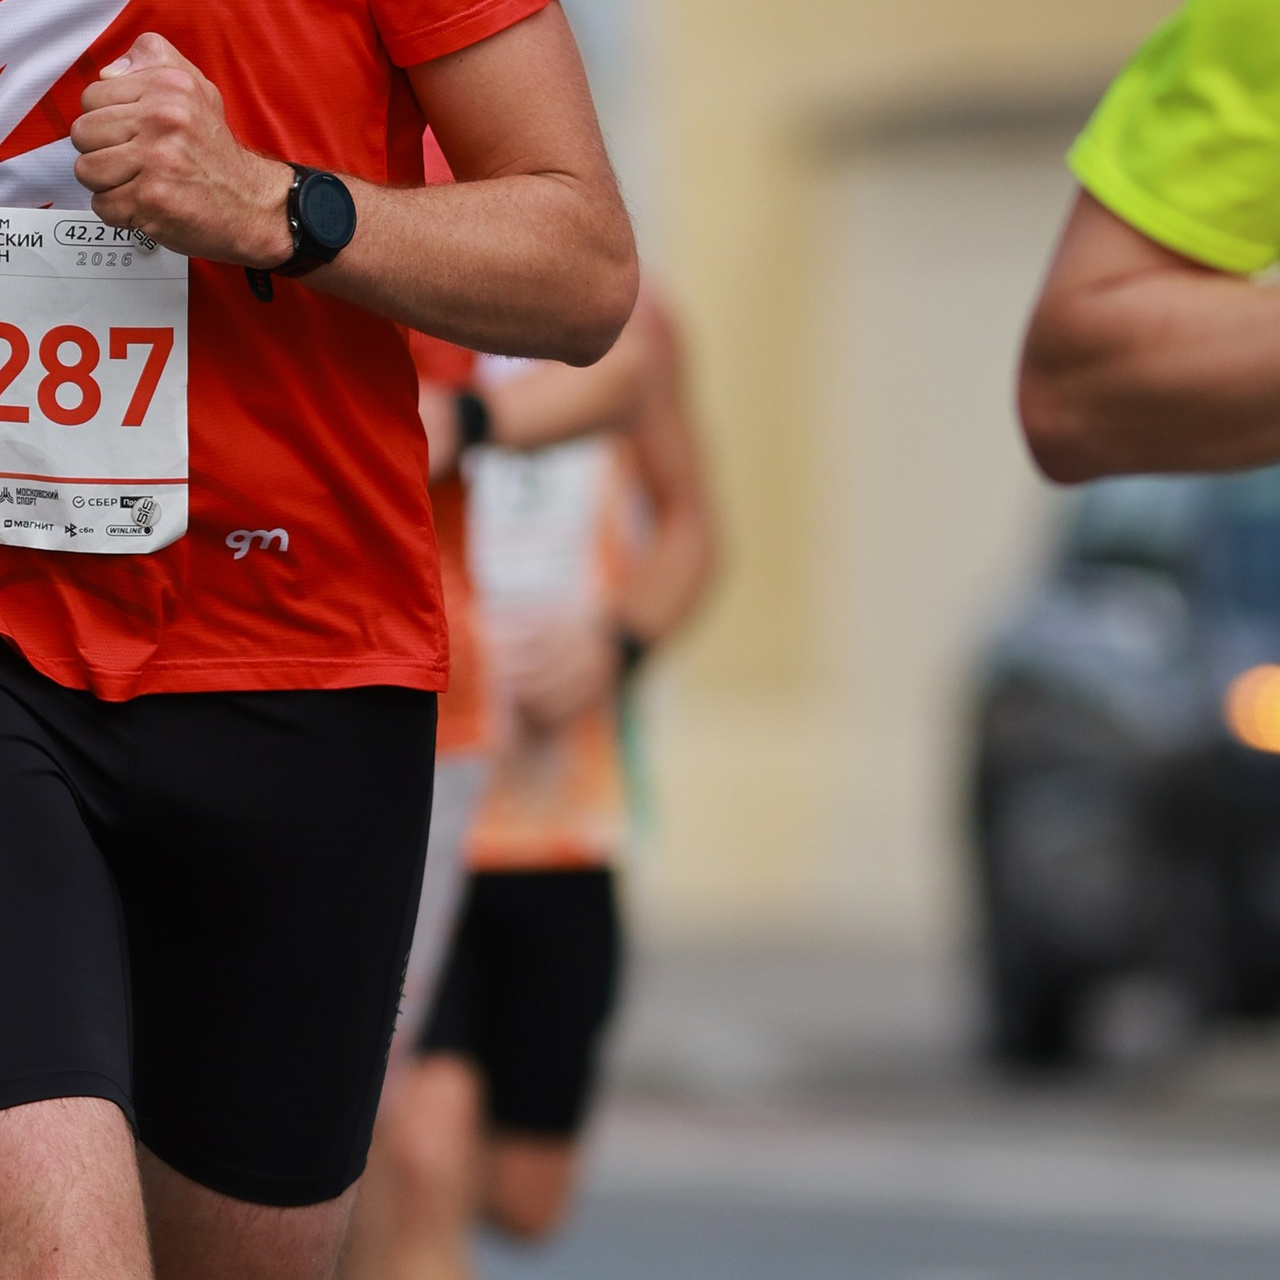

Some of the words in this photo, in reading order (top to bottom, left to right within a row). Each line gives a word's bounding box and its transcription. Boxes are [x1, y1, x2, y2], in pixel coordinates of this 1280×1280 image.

[65, 225, 106, 242] 42,2
[76, 251, 132, 266] 2026
[16, 487, 59, 500] МОСКОВСКИЙ
[16, 496, 37, 506] СПОРТ
[88, 498, 118, 507] СБЕР
